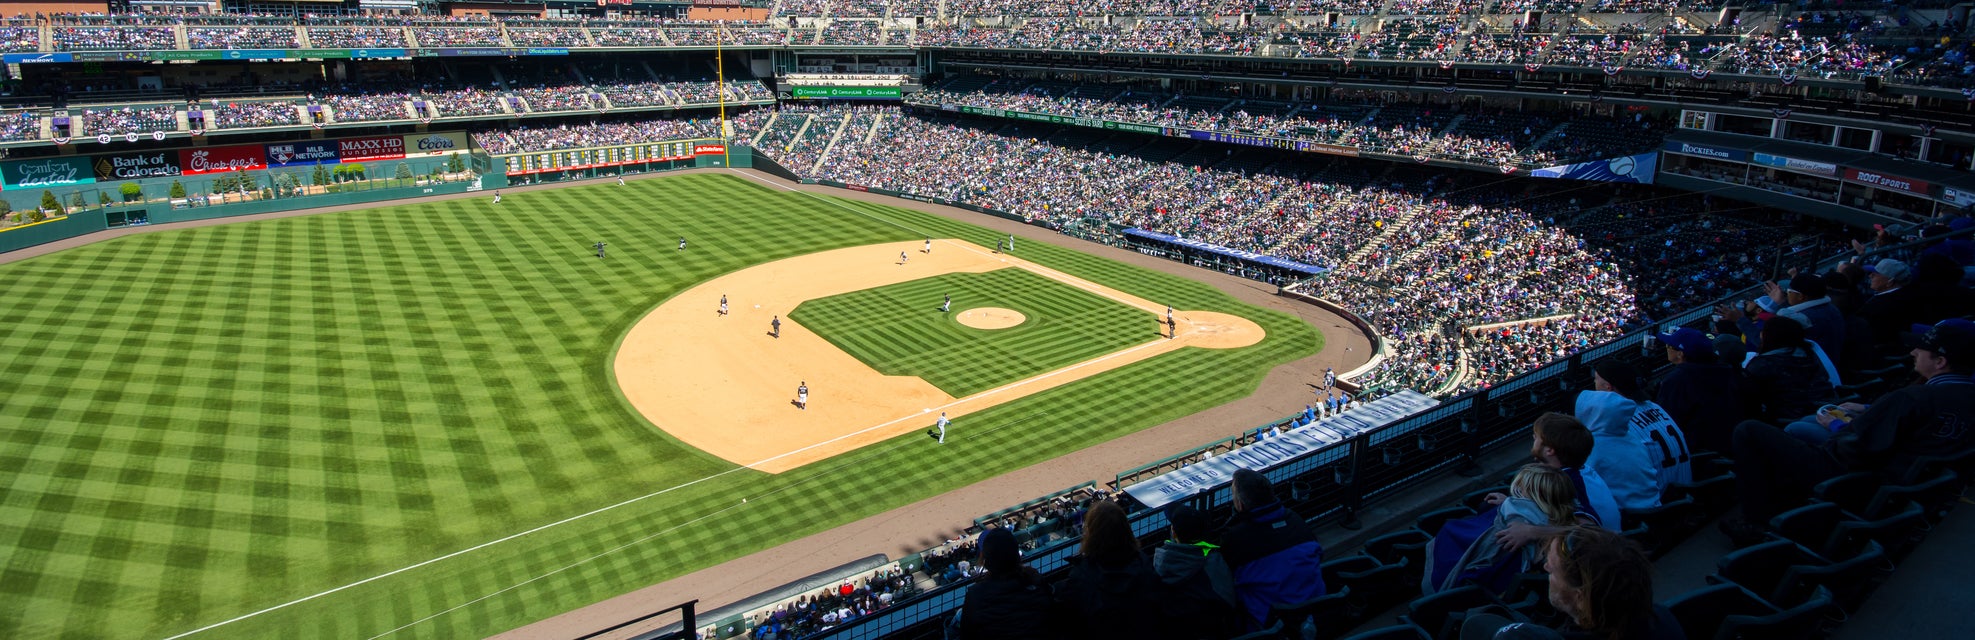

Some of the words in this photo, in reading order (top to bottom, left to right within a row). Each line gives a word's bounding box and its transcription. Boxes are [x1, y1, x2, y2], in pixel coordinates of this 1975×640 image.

[306, 145, 324, 153] MLB
[341, 139, 381, 151] MAXX
[383, 138, 403, 148] HD
[417, 136, 455, 150] Coors
[1682, 143, 1729, 158] ROCKIES.com
[113, 155, 146, 168] Bank
[150, 153, 165, 164] of
[295, 150, 335, 161] NETWORK
[19, 159, 71, 175] Comfort
[115, 163, 179, 178] Colorado
[1857, 171, 1881, 184] ROOT
[1880, 177, 1911, 191] SPORTS
[1649, 423, 1689, 469] 11
[1159, 474, 1207, 494] WELCOME
[1205, 469, 1220, 481] TO
[1223, 435, 1305, 470] COORS
[1302, 414, 1370, 451] FIELD
